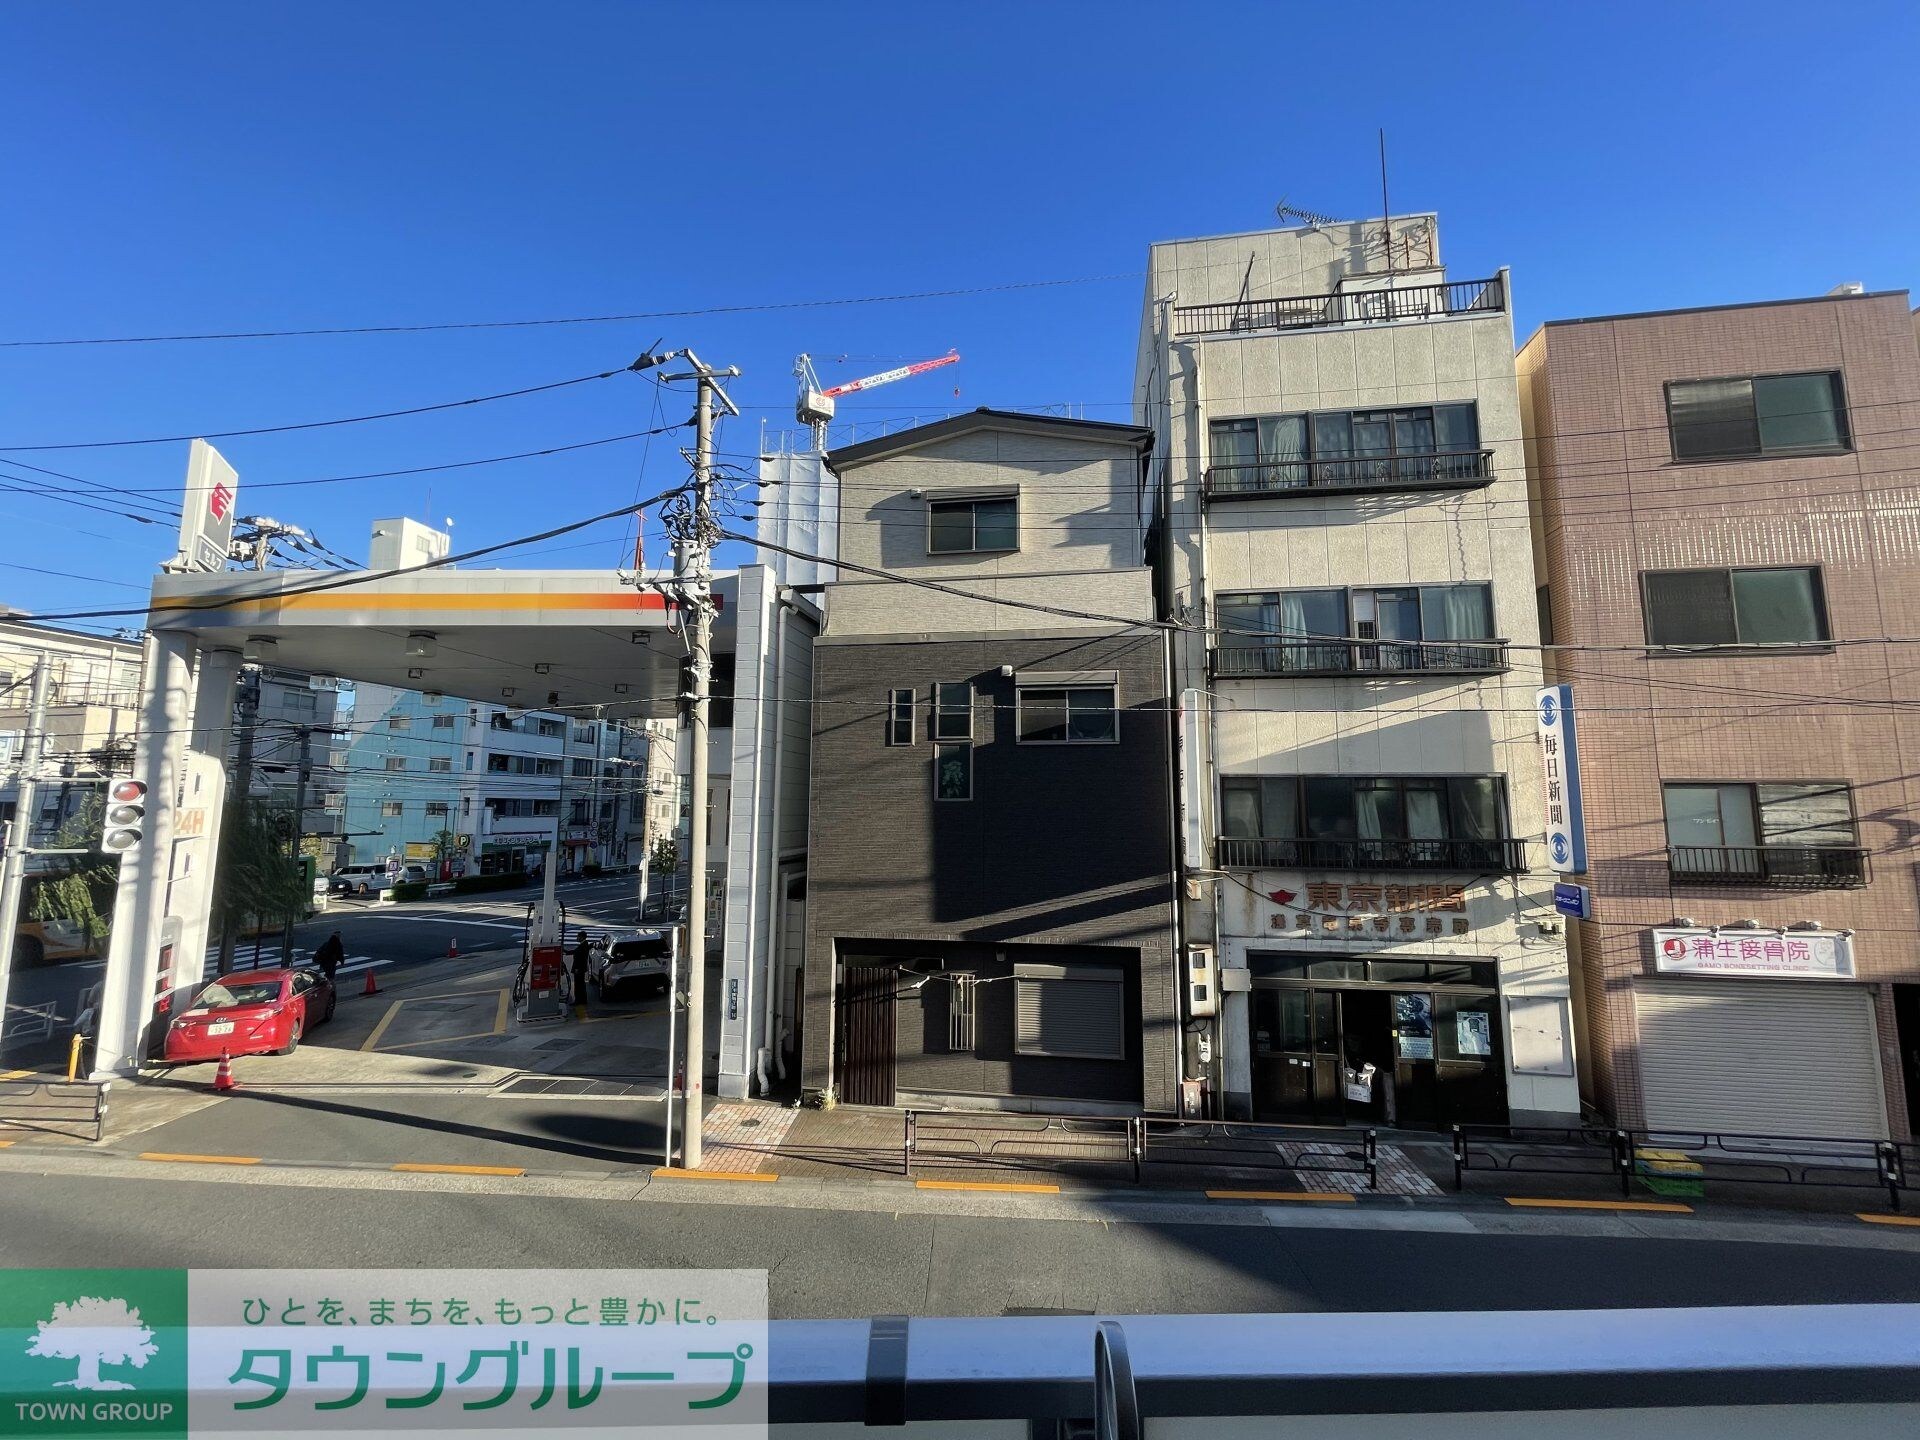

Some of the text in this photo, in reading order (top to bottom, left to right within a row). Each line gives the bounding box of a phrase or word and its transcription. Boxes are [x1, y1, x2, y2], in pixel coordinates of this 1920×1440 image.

[204, 548, 222, 570] セルフ
[1545, 734, 1563, 825] 毎日新聞
[1306, 882, 1467, 914] 東京新聞
[1691, 938, 1811, 962] 蒲生接骨院
[1697, 962, 1722, 970] GAMO
[1724, 963, 1780, 971] BONESETTING
